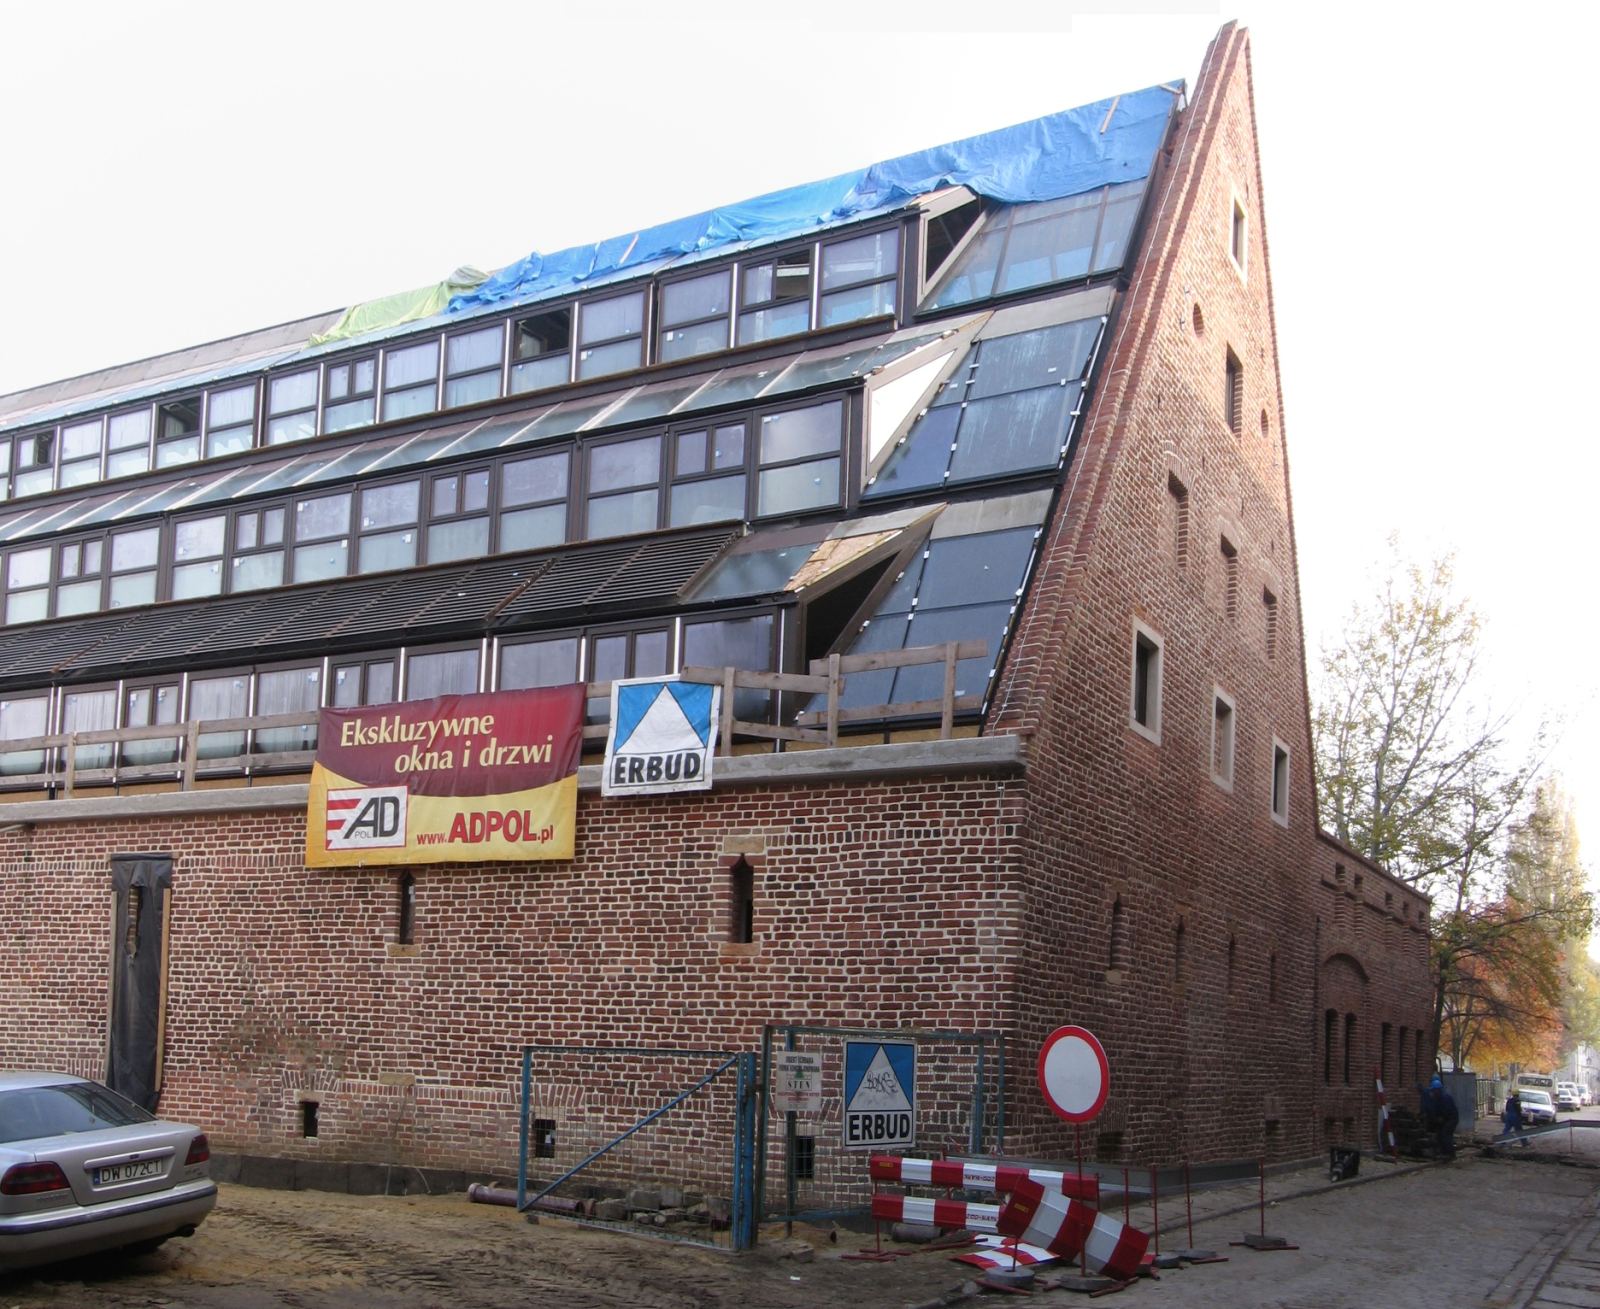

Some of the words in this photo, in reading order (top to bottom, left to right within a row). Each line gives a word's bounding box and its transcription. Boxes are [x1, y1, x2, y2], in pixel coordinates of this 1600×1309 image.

[340, 714, 495, 748] Ekskluzywne
[394, 744, 454, 773] okna
[462, 740, 472, 768] i
[479, 734, 554, 767] drzwi
[613, 752, 701, 785] ERBUD
[343, 796, 400, 840] AD
[354, 830, 372, 839] POL
[416, 809, 554, 845] www.ADPOL.pl
[849, 1113, 911, 1142] ERBUD
[101, 1167, 121, 1183] DW
